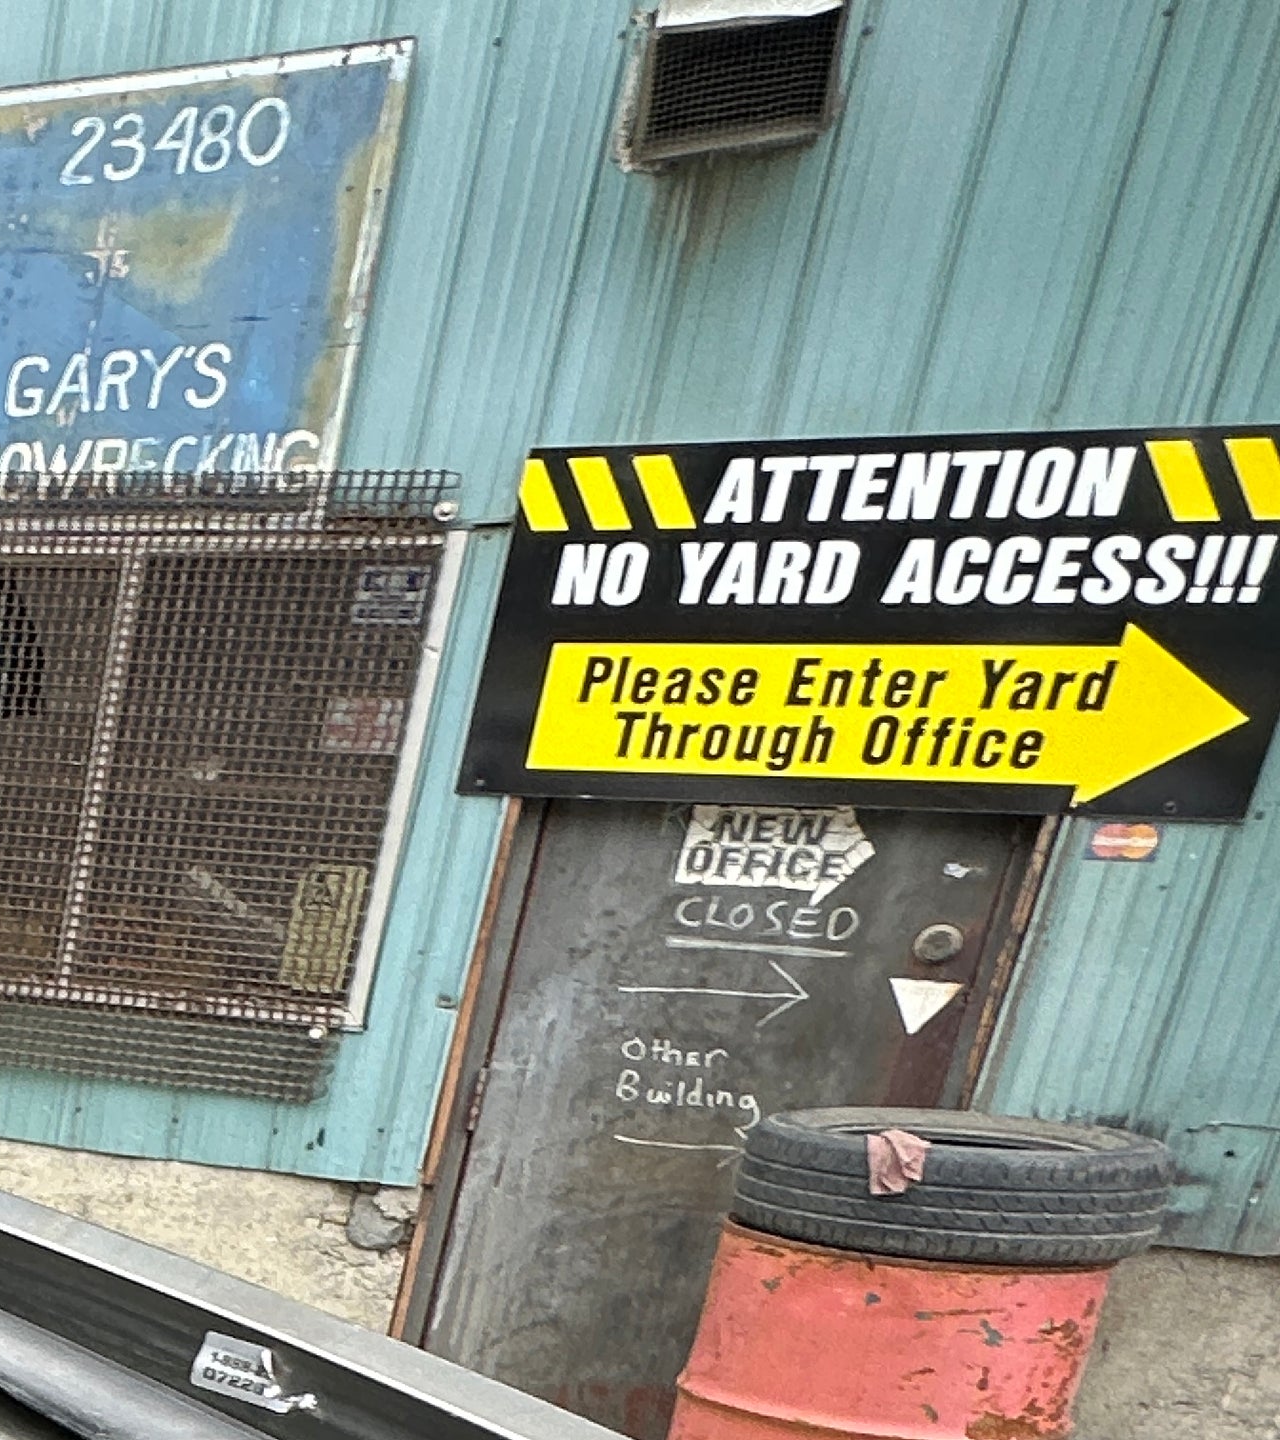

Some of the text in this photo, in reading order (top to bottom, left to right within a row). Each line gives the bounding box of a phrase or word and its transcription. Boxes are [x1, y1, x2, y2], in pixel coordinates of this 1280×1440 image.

[59, 97, 291, 186] 23480
[4, 342, 231, 418] GARY'S
[704, 446, 1137, 523] ATTENTION
[551, 534, 1278, 606] NO YARD ACCESS!!!
[578, 656, 1118, 711] Please Enter Yard
[614, 711, 1044, 772] Through Office
[713, 811, 833, 844] NEW
[687, 842, 845, 882] OFFICE
[675, 896, 859, 941] CLOSED
[615, 1069, 760, 1131] Building
